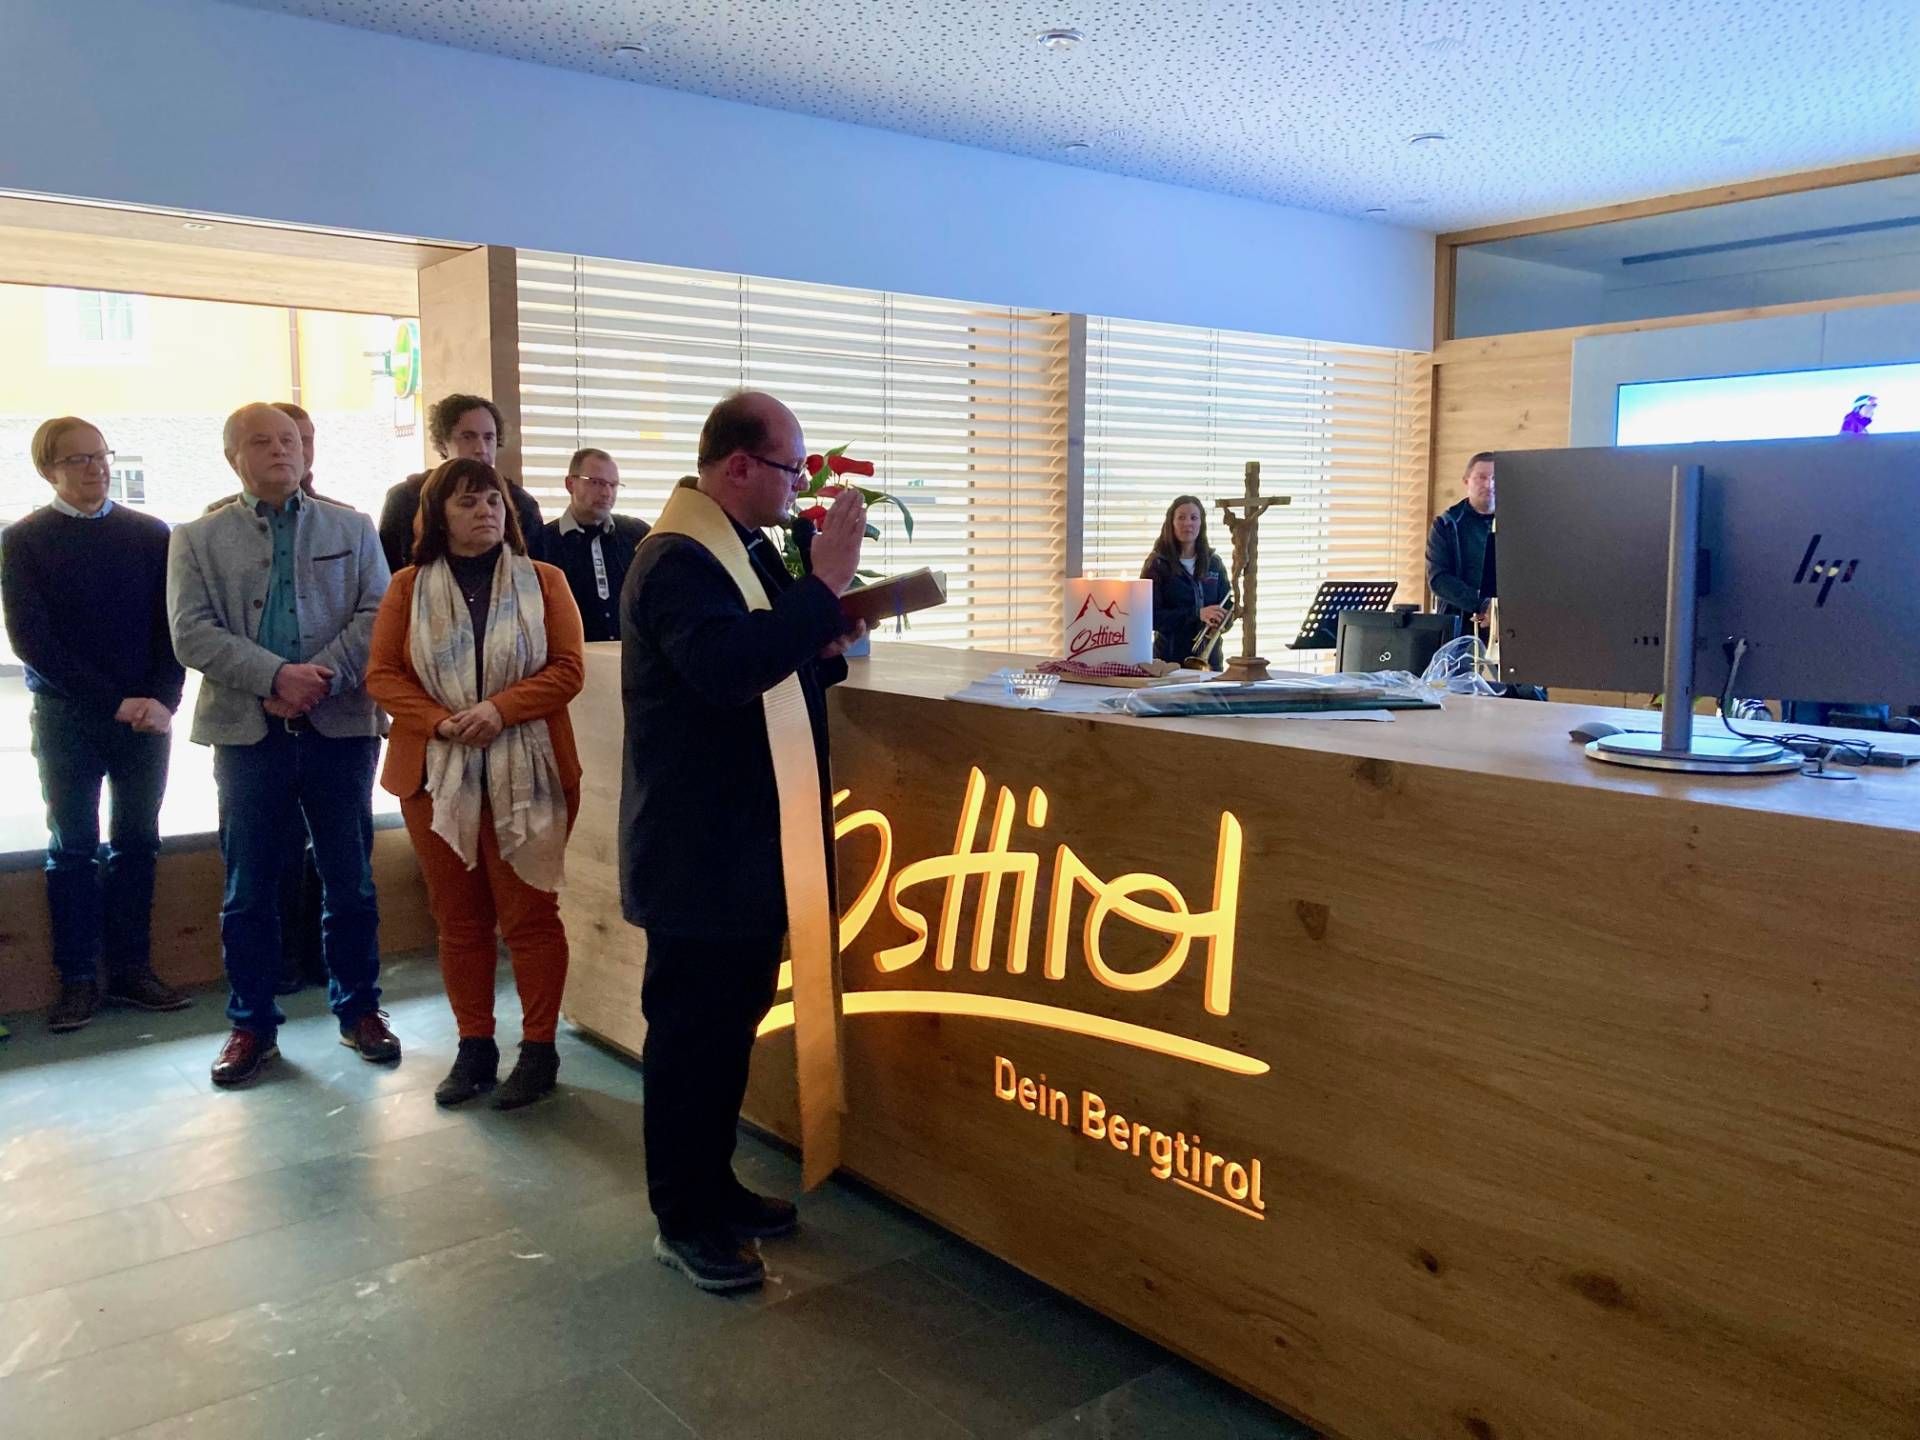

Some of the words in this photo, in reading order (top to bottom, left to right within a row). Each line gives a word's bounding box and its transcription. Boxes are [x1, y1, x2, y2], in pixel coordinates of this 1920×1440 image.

[1793, 534, 1859, 607] hp
[1070, 625, 1125, 653] Osttirol
[995, 1055, 1069, 1126] Dein
[1082, 1090, 1265, 1210] Bergtirol
